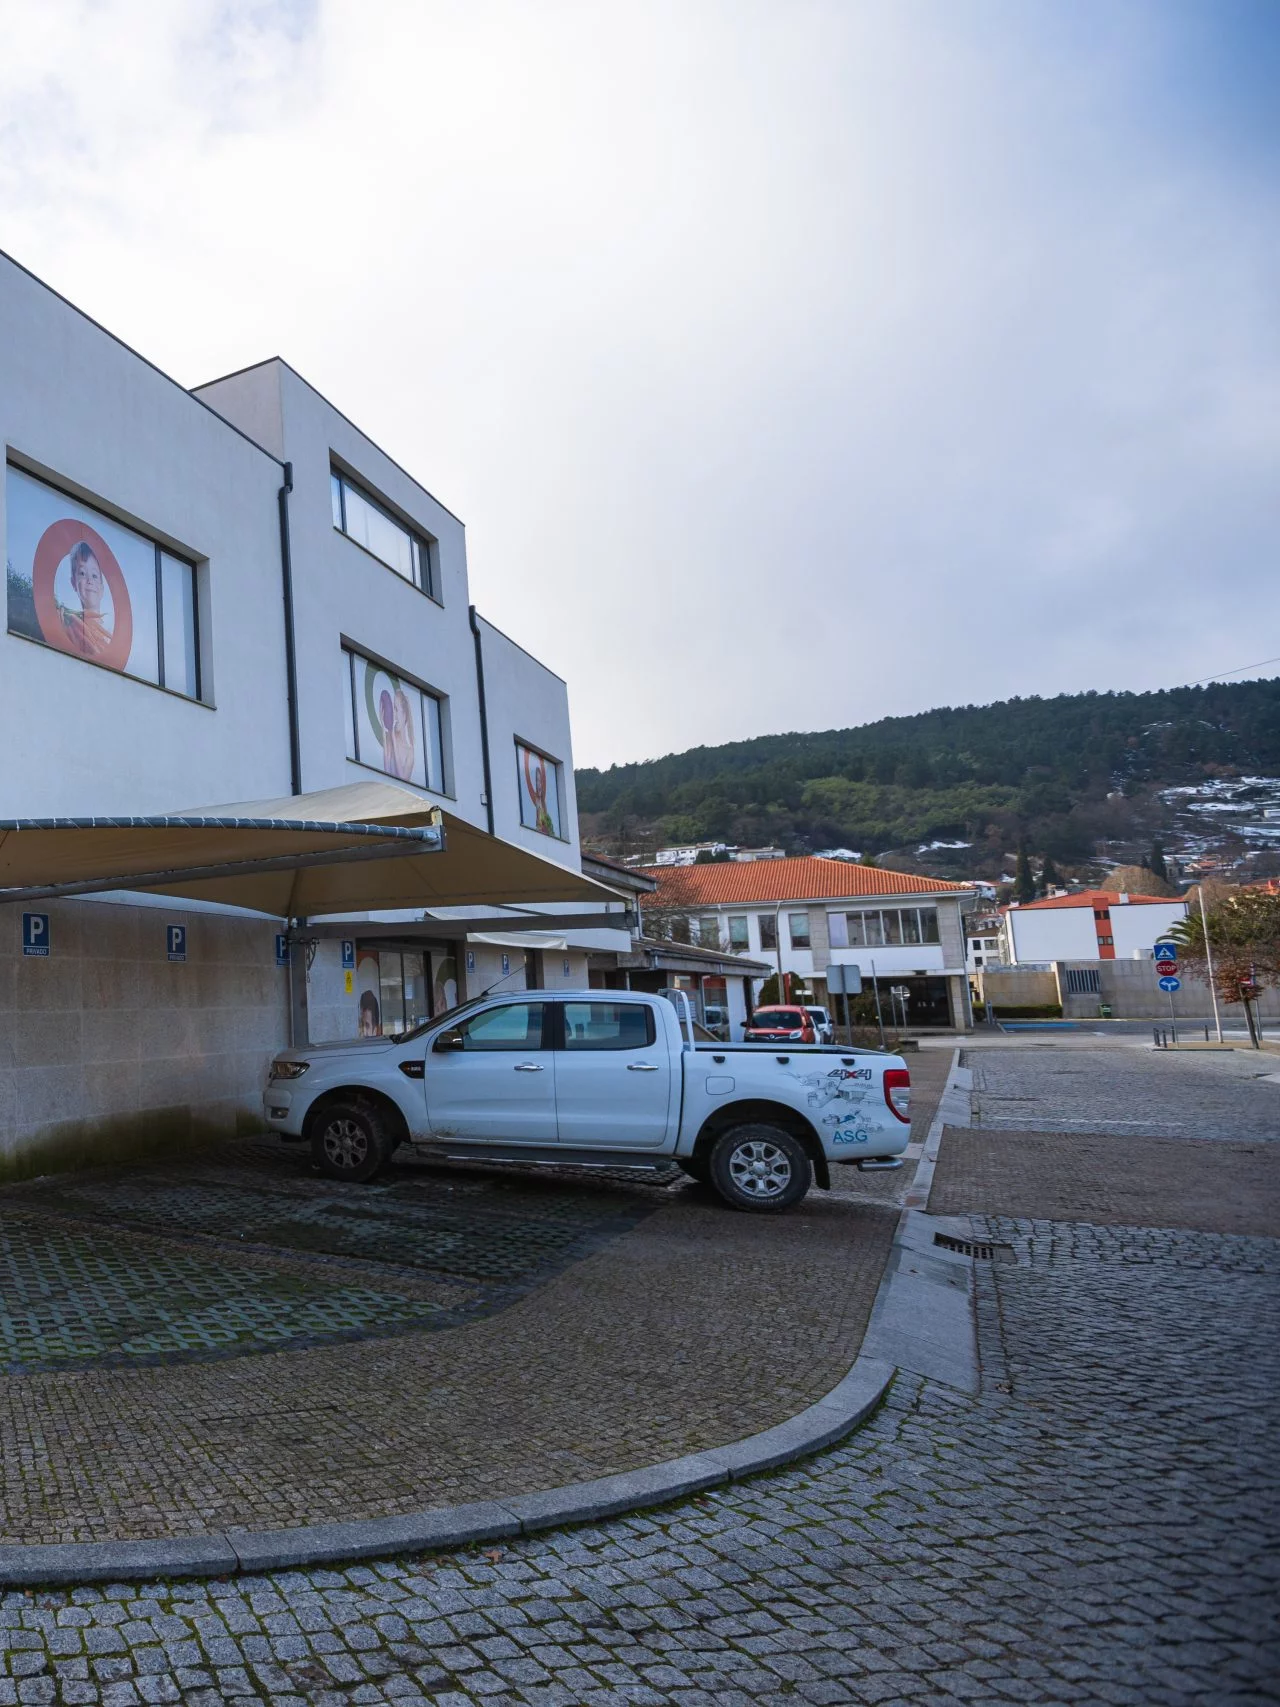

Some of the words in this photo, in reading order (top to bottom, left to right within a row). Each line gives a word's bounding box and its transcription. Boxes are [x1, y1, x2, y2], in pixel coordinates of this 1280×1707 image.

[30, 916, 44, 944] P
[172, 927, 182, 951] P
[344, 942, 352, 960] P
[468, 952, 474, 967] P
[503, 954, 508, 970] P
[833, 1130, 868, 1142] ASG
